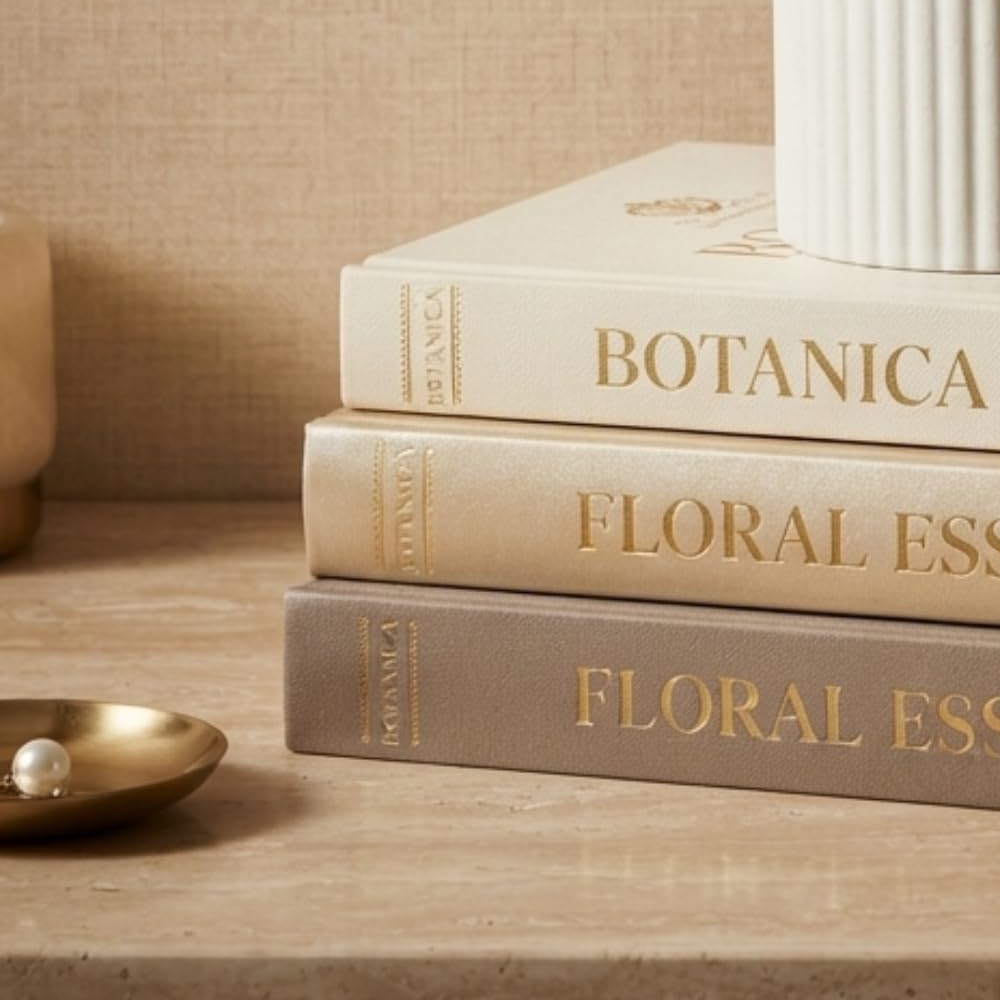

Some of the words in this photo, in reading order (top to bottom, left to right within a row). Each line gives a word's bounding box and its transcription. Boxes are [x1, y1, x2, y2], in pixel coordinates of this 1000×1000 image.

[594, 328, 987, 409] BOTANICA
[576, 491, 868, 569] FLORAL
[574, 666, 862, 745] FLORAL
